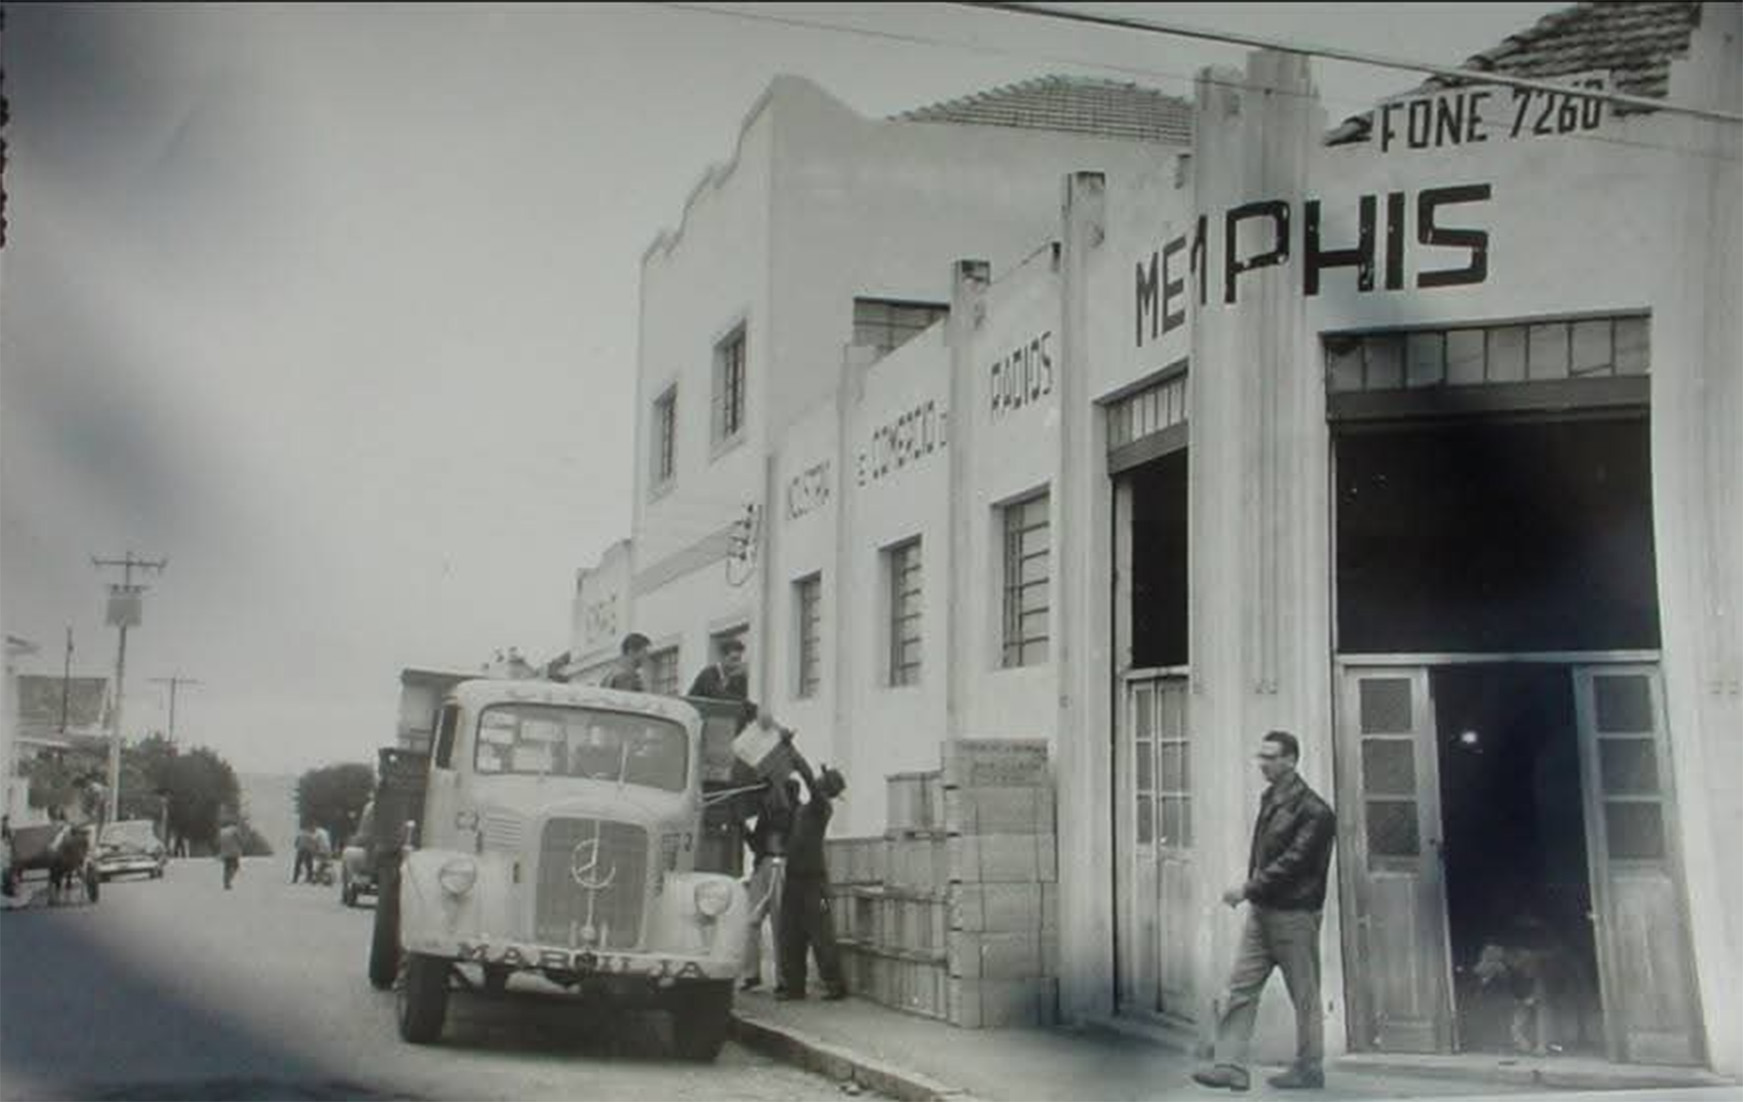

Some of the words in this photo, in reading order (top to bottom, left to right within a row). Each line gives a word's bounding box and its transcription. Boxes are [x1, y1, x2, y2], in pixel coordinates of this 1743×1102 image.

[1381, 91, 1492, 152] FONE
[1510, 78, 1604, 139] 7260
[1136, 183, 1491, 347] MEMPHIS
[991, 330, 1053, 421] RADIOS
